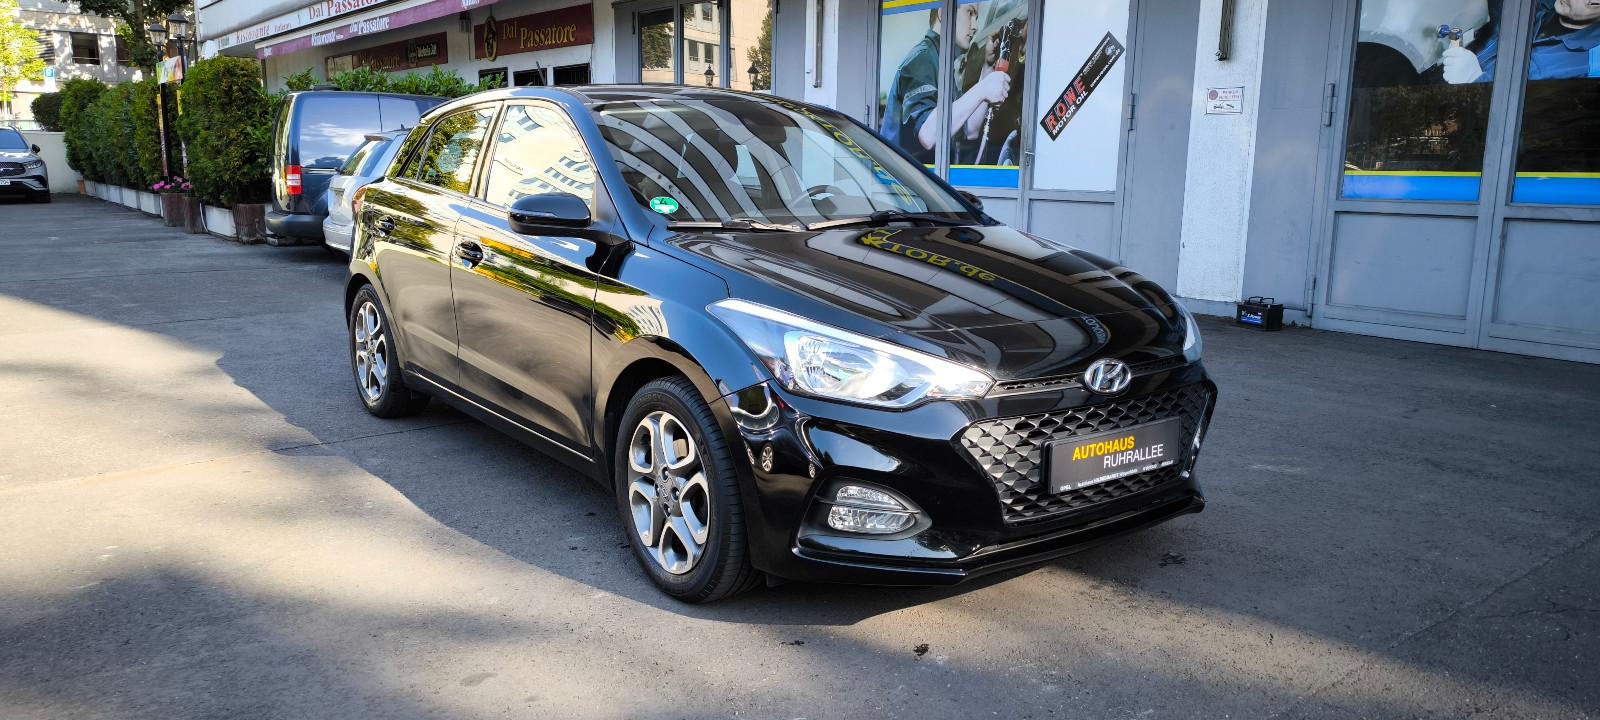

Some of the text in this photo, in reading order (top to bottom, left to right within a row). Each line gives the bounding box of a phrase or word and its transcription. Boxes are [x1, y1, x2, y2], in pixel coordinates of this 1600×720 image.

[308, 3, 324, 19] Dal
[358, 16, 390, 35] Passatore
[503, 21, 577, 49] Dal Passatore
[1044, 73, 1086, 132] ROWE
[1052, 90, 1088, 136] MOTOR OIL
[1072, 435, 1135, 461] AUTOHAUS
[1103, 443, 1164, 469] RUHRALLEE
